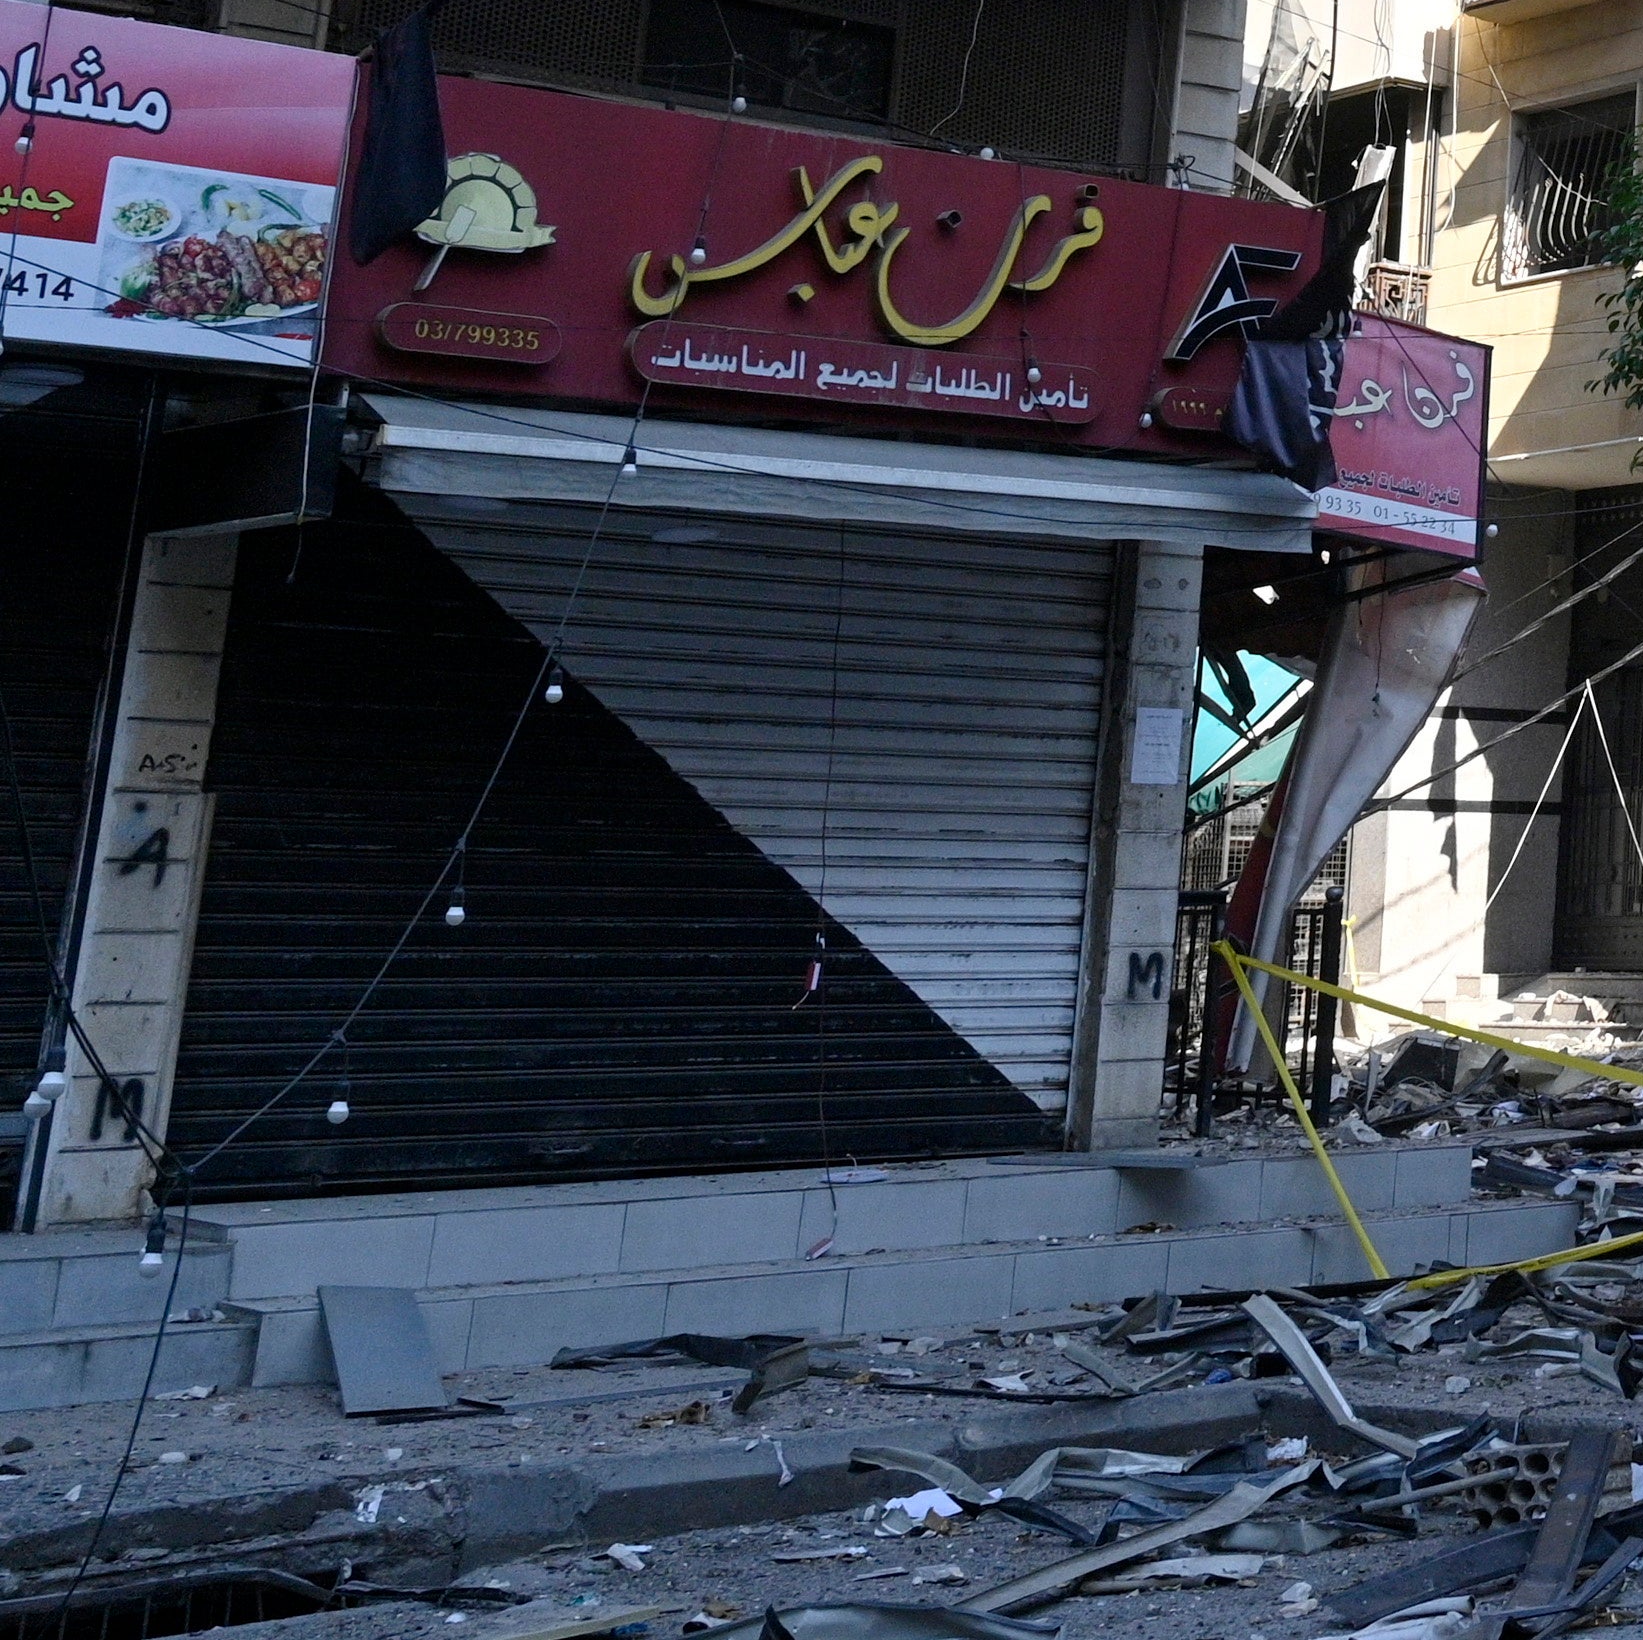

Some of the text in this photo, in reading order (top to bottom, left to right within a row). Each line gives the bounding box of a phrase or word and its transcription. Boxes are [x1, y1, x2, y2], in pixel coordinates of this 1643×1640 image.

[629, 156, 1104, 346] فرن عباس
[415, 317, 540, 350] 03/799335
[650, 338, 806, 380] المناسبات
[815, 360, 898, 390] لجميع
[906, 366, 1010, 401] الطلبات
[1402, 349, 1475, 429] فرن
[1373, 505, 1390, 521] 01
[1127, 951, 1166, 1001] M
